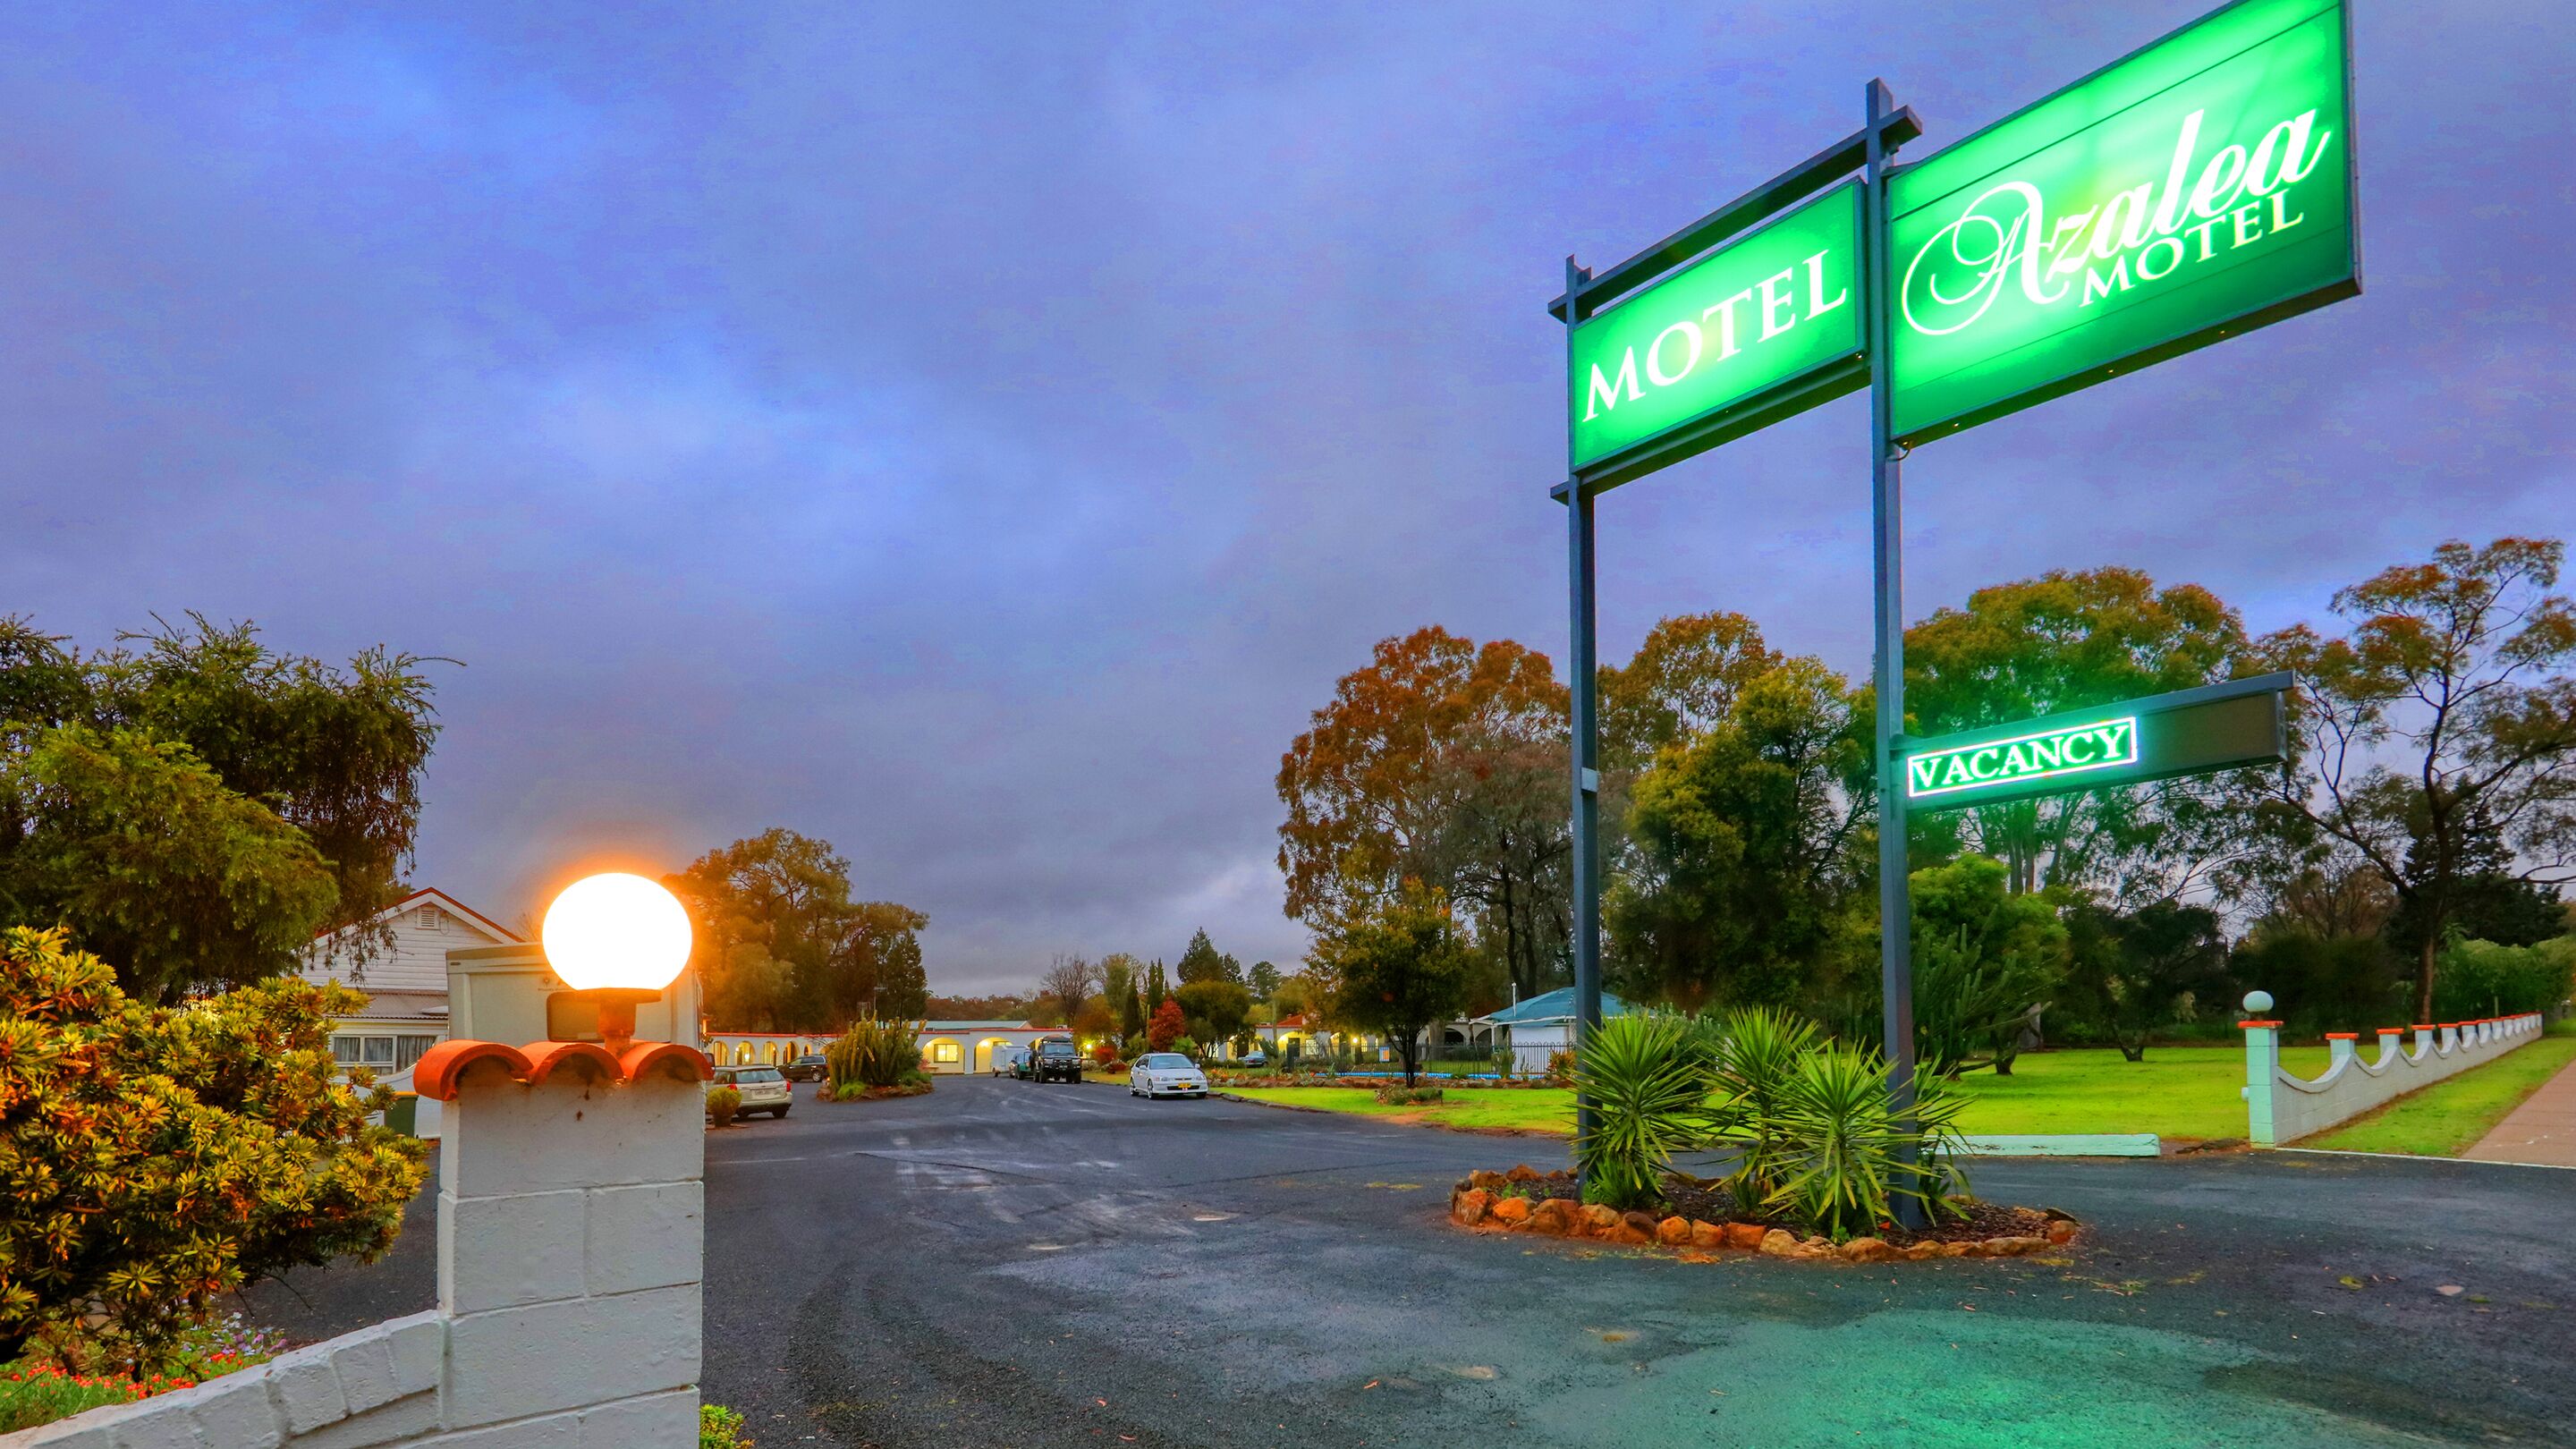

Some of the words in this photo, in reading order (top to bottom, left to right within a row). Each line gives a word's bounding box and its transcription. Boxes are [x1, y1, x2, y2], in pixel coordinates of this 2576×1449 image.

[1902, 108, 2331, 335] Azalea
[2079, 188, 2304, 307] MOTEL
[1582, 249, 1847, 422] MOTEL
[1912, 725, 2130, 788] VACANCY
